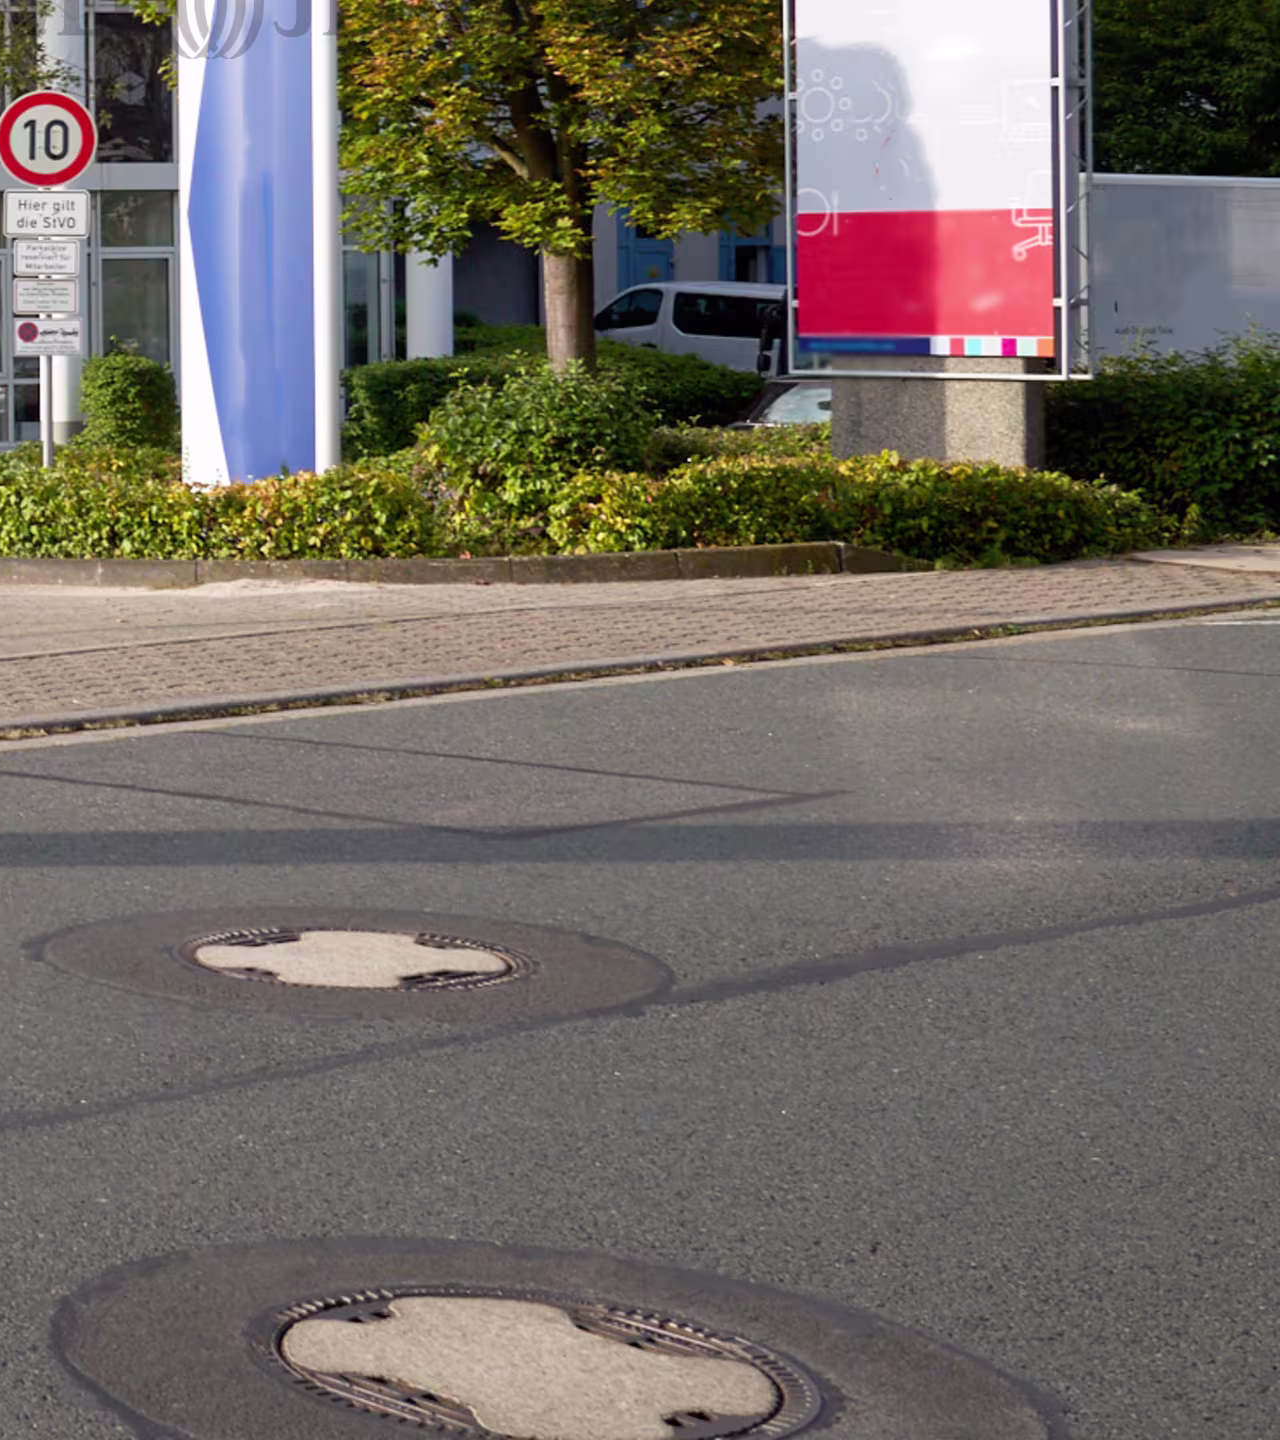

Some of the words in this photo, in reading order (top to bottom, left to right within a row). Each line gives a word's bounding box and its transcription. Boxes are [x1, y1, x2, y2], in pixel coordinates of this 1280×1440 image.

[23, 119, 69, 161] 10
[18, 199, 47, 211] Hier
[52, 199, 76, 213] gilt
[16, 217, 38, 229] die
[42, 216, 77, 229] StVO
